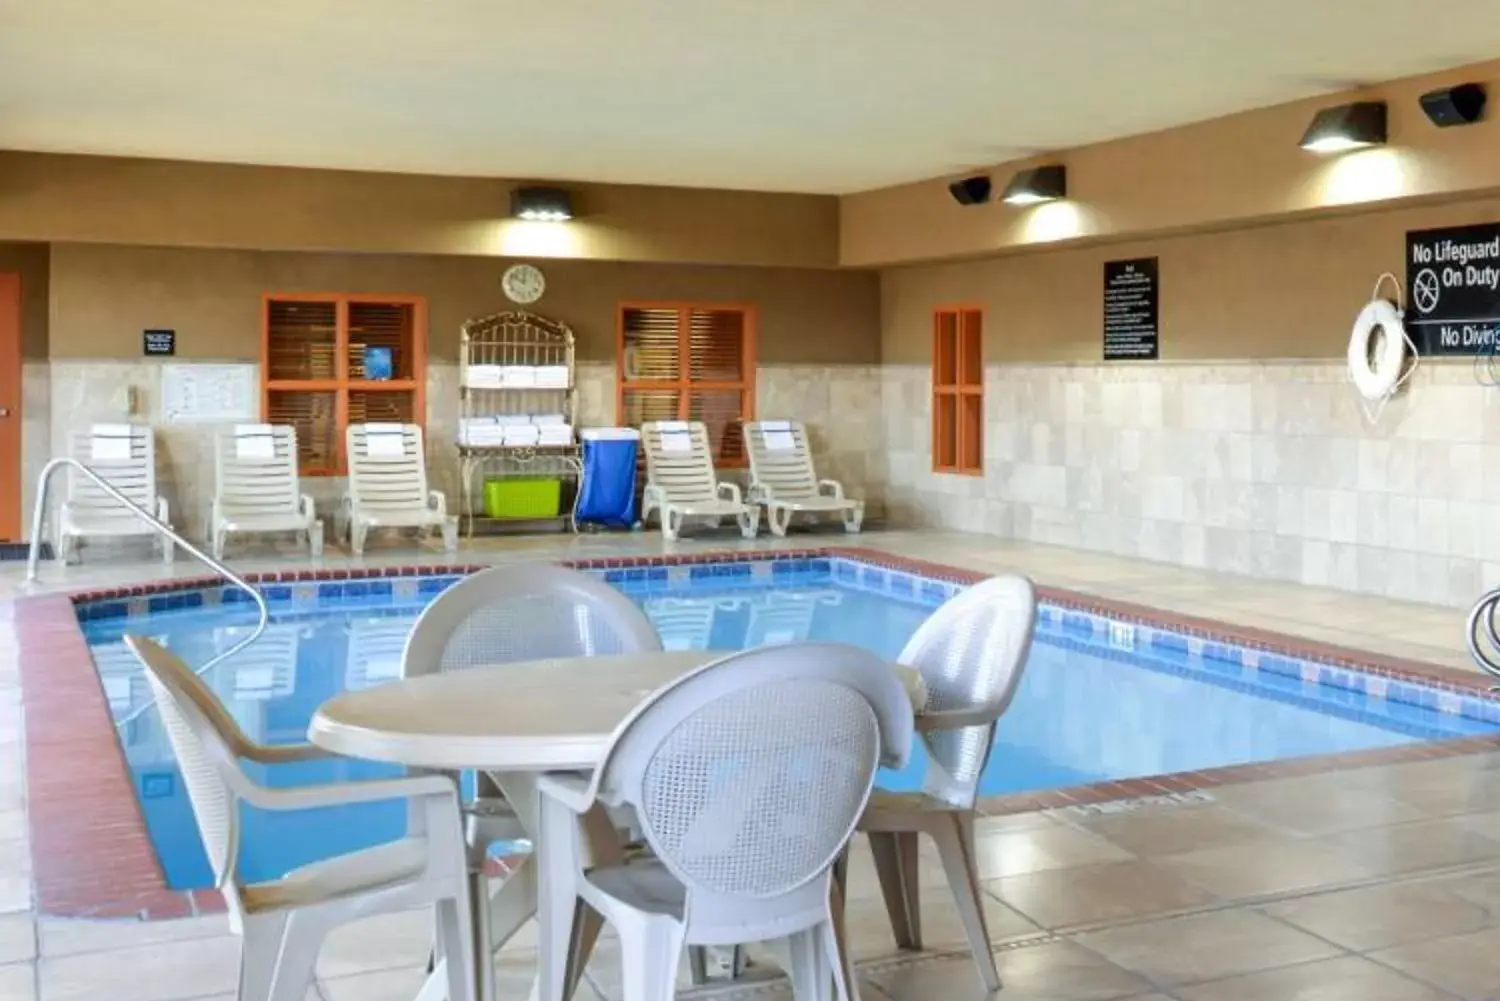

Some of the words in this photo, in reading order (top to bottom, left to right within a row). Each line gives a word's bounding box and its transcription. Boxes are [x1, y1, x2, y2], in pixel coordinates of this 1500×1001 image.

[1412, 243, 1432, 263] No
[1435, 235, 1500, 265] Lifeguard
[1442, 267, 1462, 287] On
[1465, 265, 1500, 290] Duty
[1441, 326, 1460, 347] No
